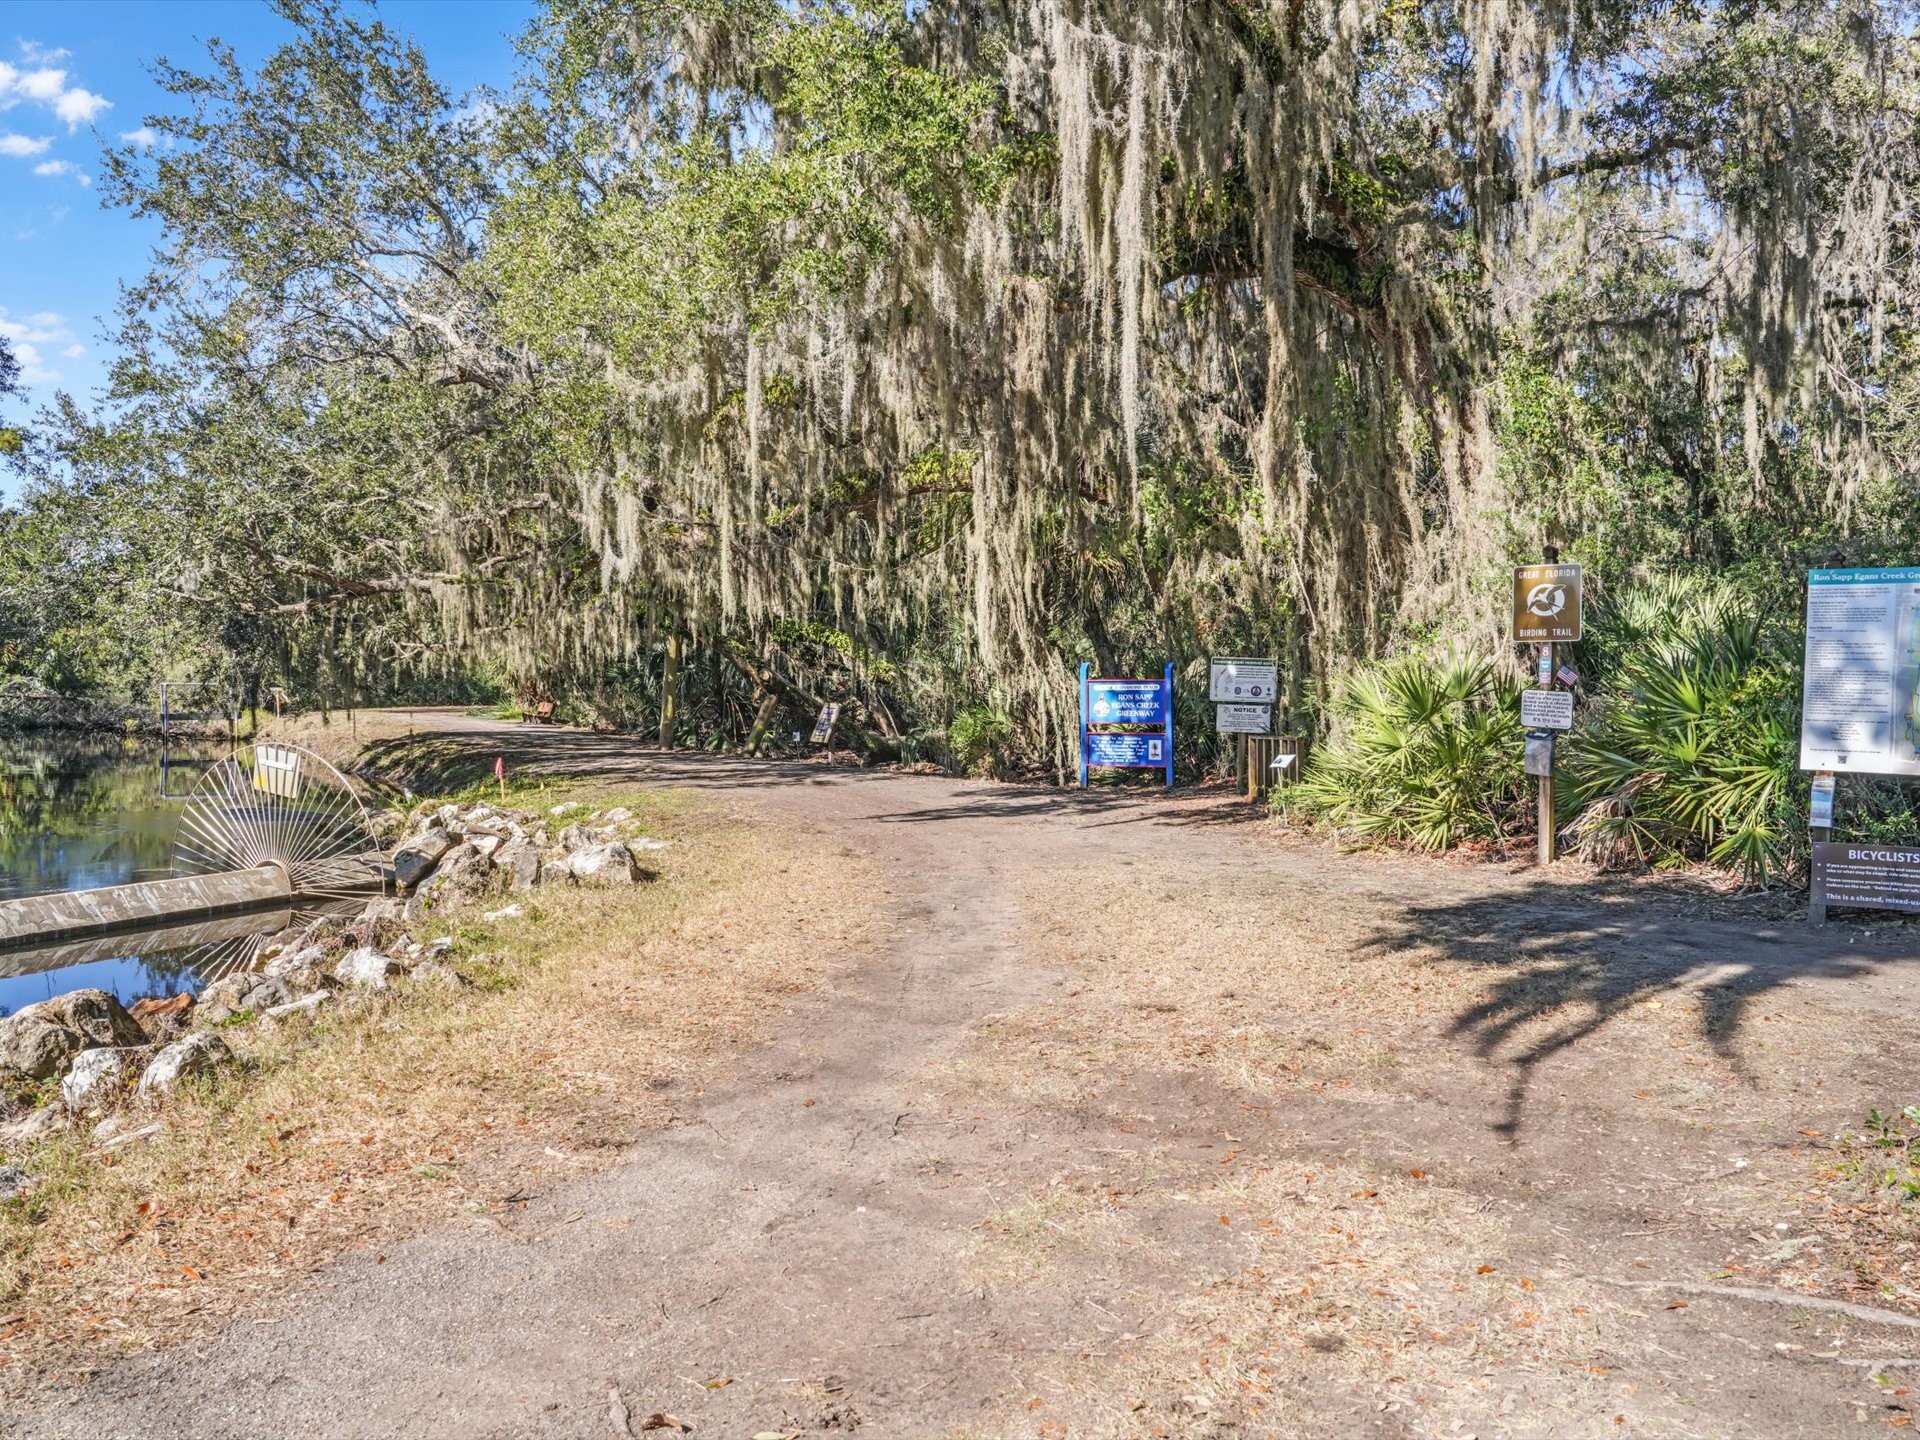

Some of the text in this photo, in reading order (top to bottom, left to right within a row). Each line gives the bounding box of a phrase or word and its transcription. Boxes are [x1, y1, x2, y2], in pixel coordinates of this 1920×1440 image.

[1518, 568, 1576, 579] GREAT FLORIDA
[1854, 573, 1878, 581] Egans
[1520, 628, 1572, 637] BIRDING TRAIL
[1542, 646, 1549, 656] 8
[1848, 850, 1920, 863] BICYCLISTS
[1856, 895, 1884, 903] shared,
